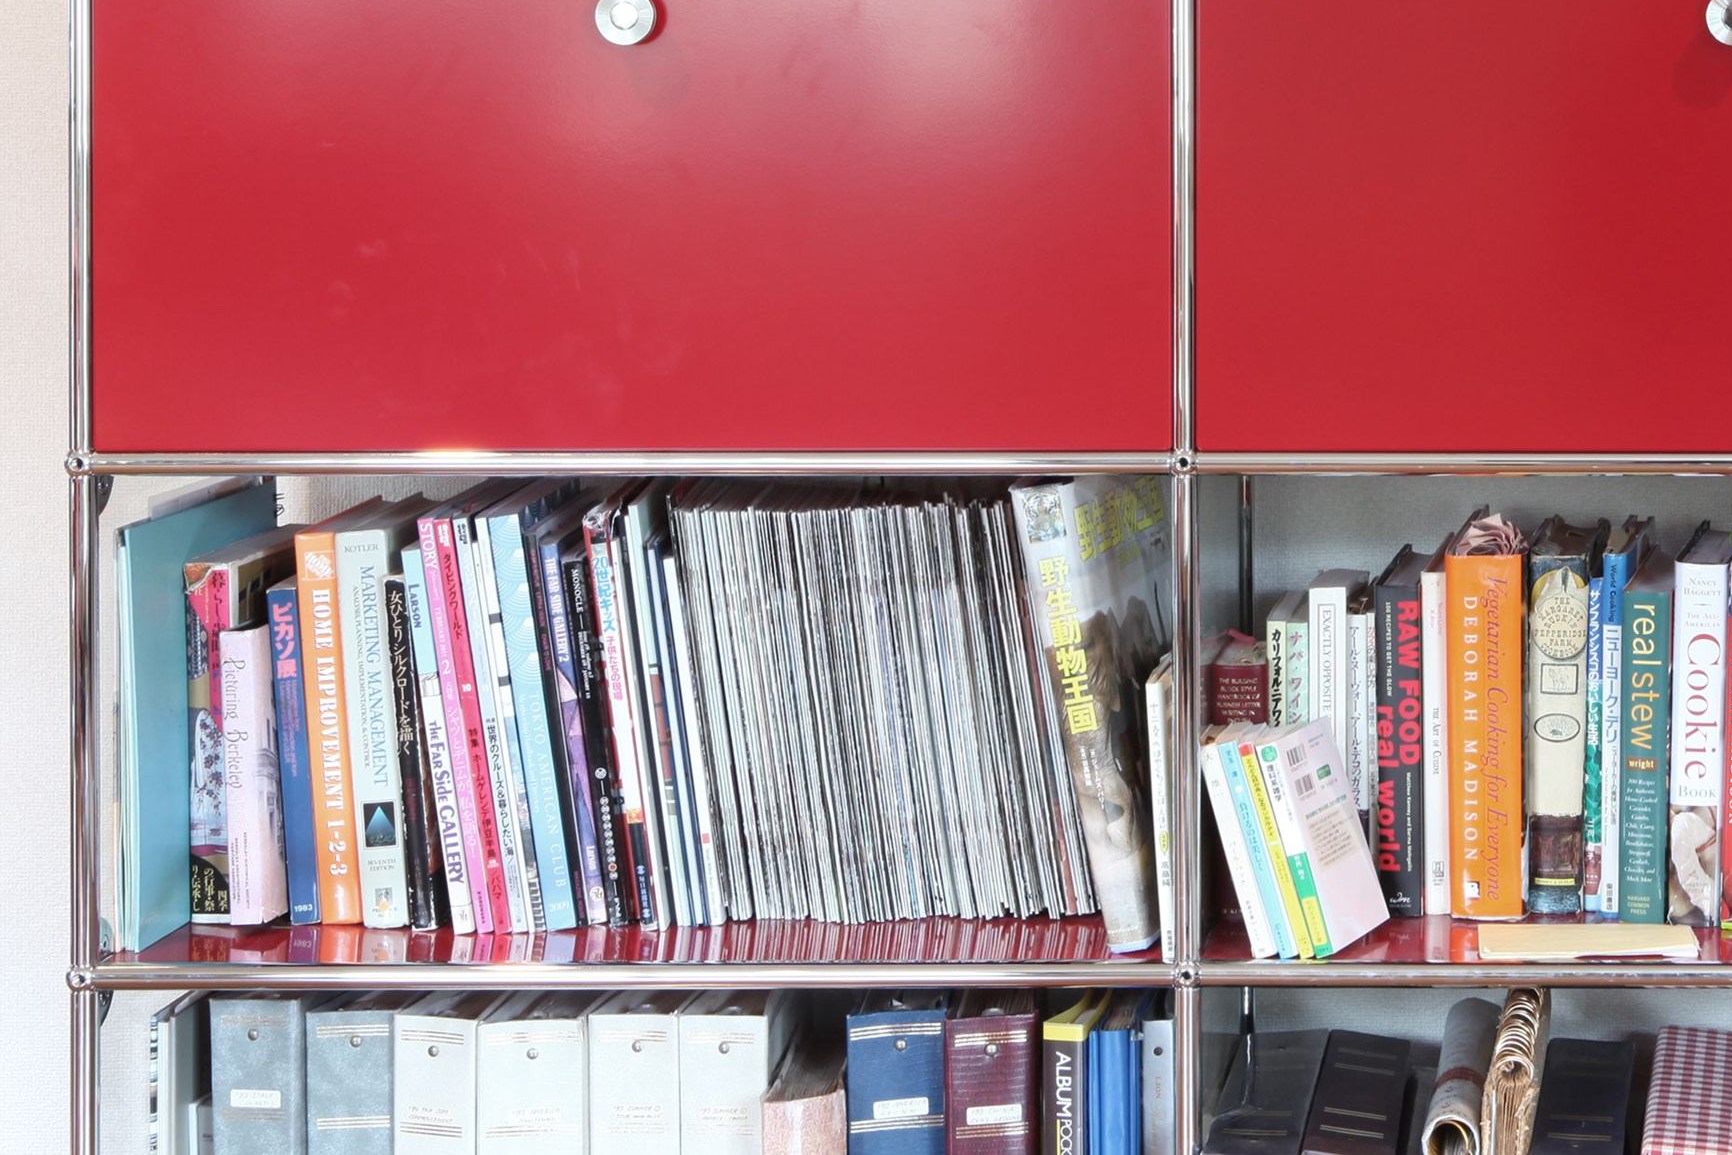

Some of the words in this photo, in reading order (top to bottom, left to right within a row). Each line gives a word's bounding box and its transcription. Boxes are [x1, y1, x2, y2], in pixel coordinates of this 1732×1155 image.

[344, 543, 380, 552] KOTLER
[420, 522, 438, 572] STORY
[408, 583, 422, 628] LARSON
[571, 569, 584, 613] MONOCLE
[593, 558, 615, 632] 20世紀キッズ
[1683, 588, 1721, 596] BAGGETT
[1689, 578, 1717, 586] NANCY
[272, 602, 298, 679] ピカソ展
[311, 589, 331, 650] HOME
[360, 565, 381, 665] MARKETING
[1037, 557, 1100, 735] 野生動物王国
[1398, 599, 1420, 669] RAW
[1534, 630, 1586, 638] PEPPERIDGE
[1632, 603, 1662, 665] real
[224, 657, 246, 719] Picturing
[1463, 595, 1479, 723] DEBORAH
[316, 656, 345, 809] IMPROVEMENT
[366, 669, 389, 787] MANAGEMENT
[529, 693, 544, 744] TOKYO
[1378, 704, 1394, 768] real
[1399, 679, 1420, 765] FOOD
[1632, 672, 1661, 751] stew
[1684, 633, 1721, 779] Cookie
[226, 729, 250, 789] Berkeley
[1628, 759, 1655, 770] wright
[535, 752, 558, 836] AMERICAN
[1378, 772, 1401, 873] world
[1463, 738, 1479, 862] MADISON
[1678, 785, 1717, 798] BOOK
[326, 814, 348, 877] 1-2-3
[550, 842, 566, 888] CLUB
[294, 903, 313, 913] 1983
[548, 901, 570, 913] 2009
